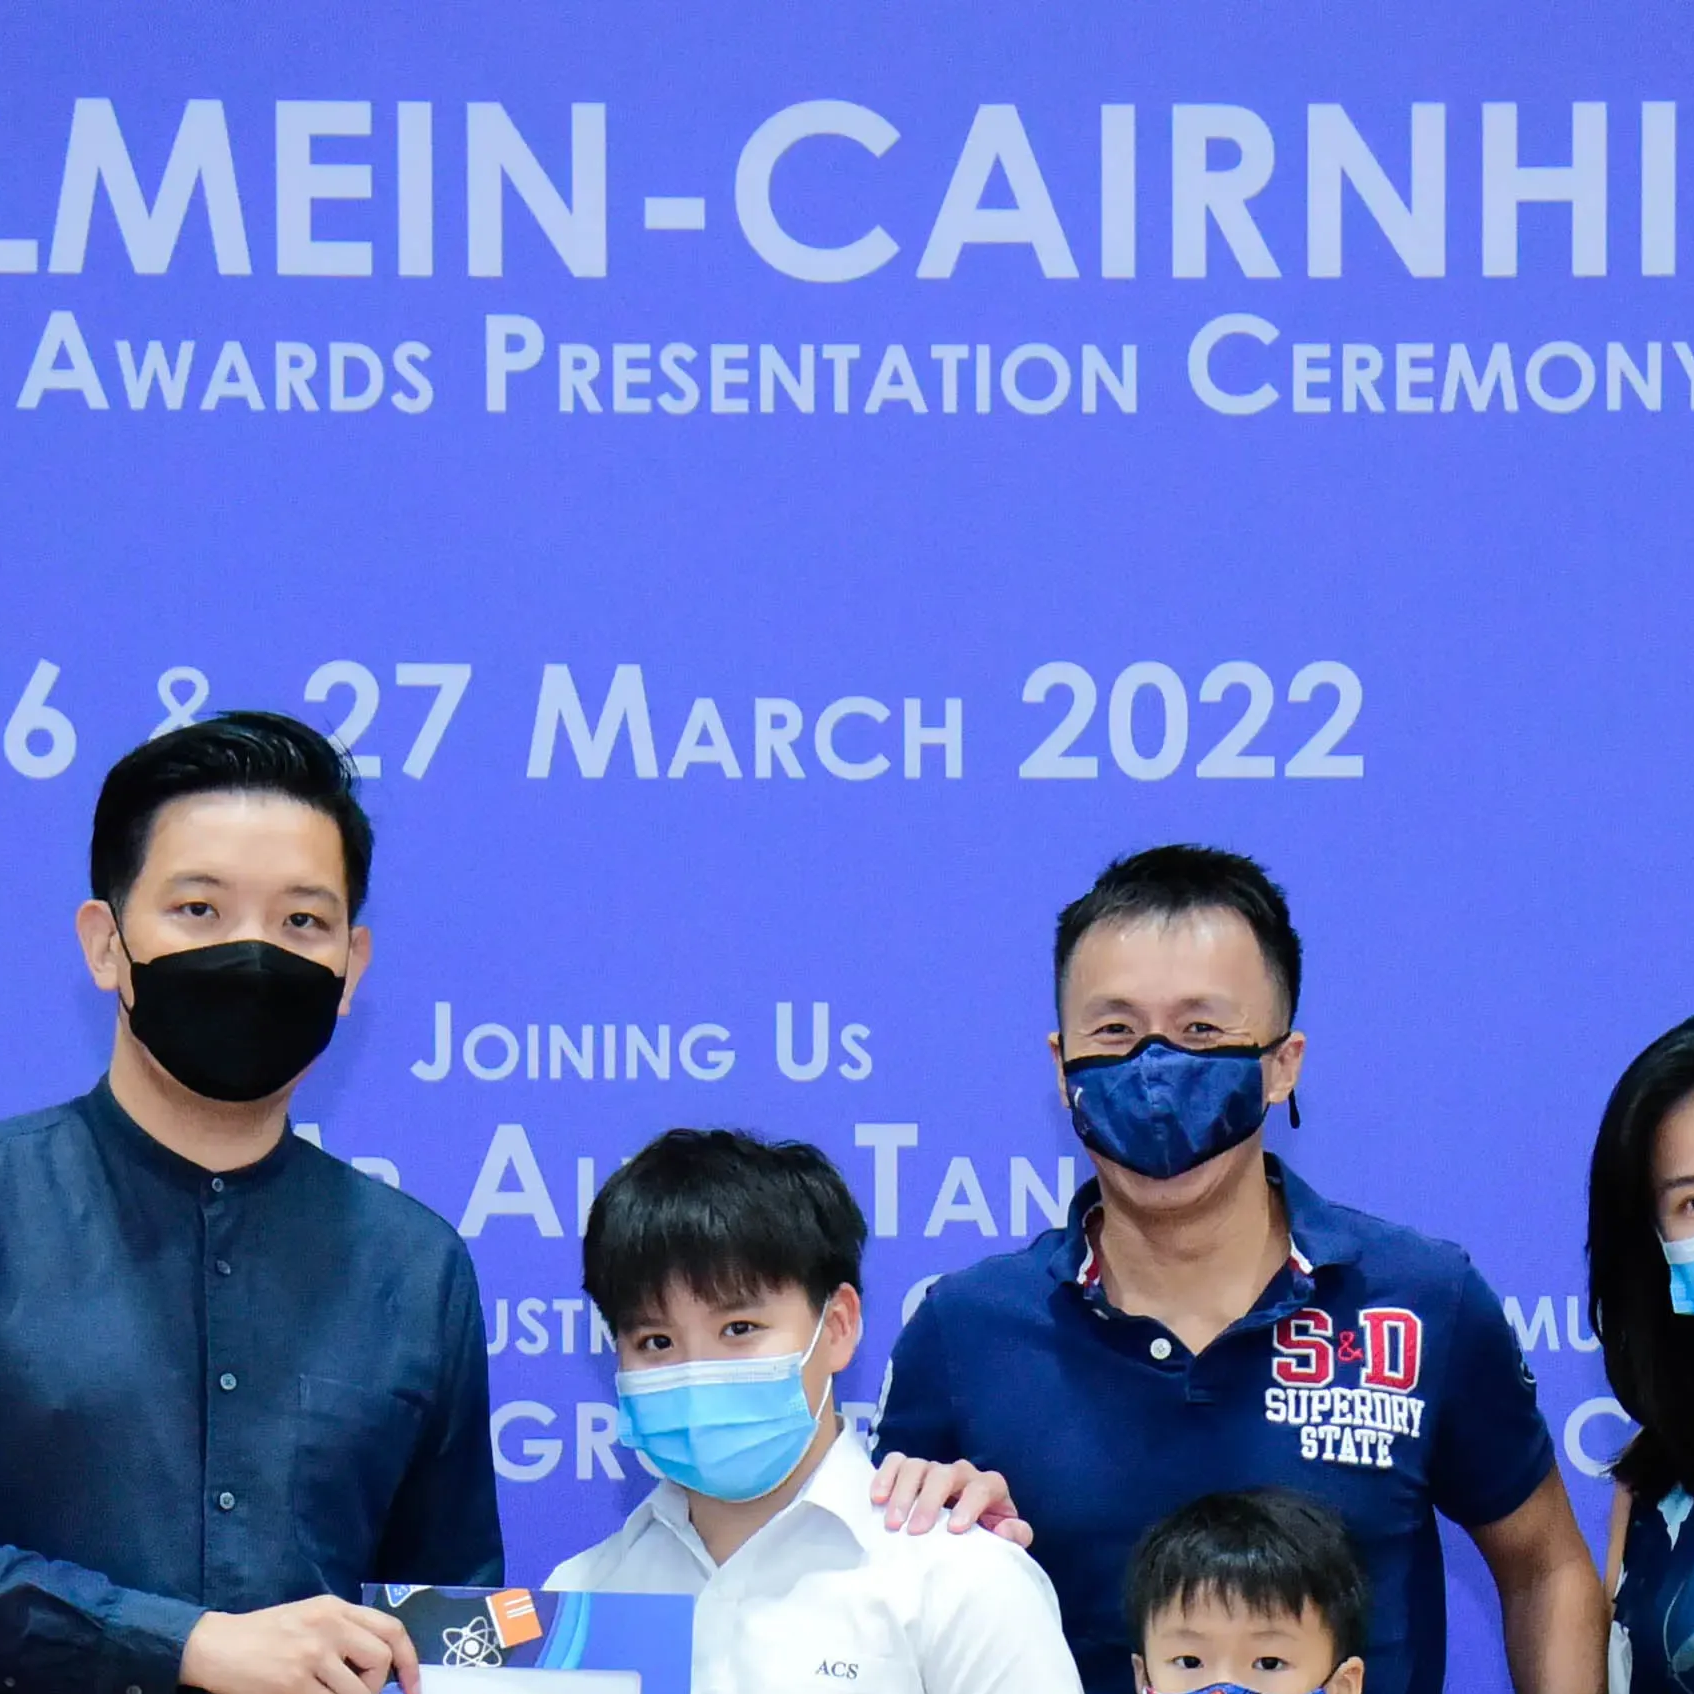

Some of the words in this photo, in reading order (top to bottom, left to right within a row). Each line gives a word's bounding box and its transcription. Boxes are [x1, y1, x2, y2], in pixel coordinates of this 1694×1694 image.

[149, 666, 210, 740] &
[303, 660, 473, 781] 27
[1018, 660, 1365, 782] 2022
[1265, 1386, 1425, 1438] SUPERDRY
[1300, 1424, 1394, 1468] STATE
[815, 1658, 860, 1681] ACS
